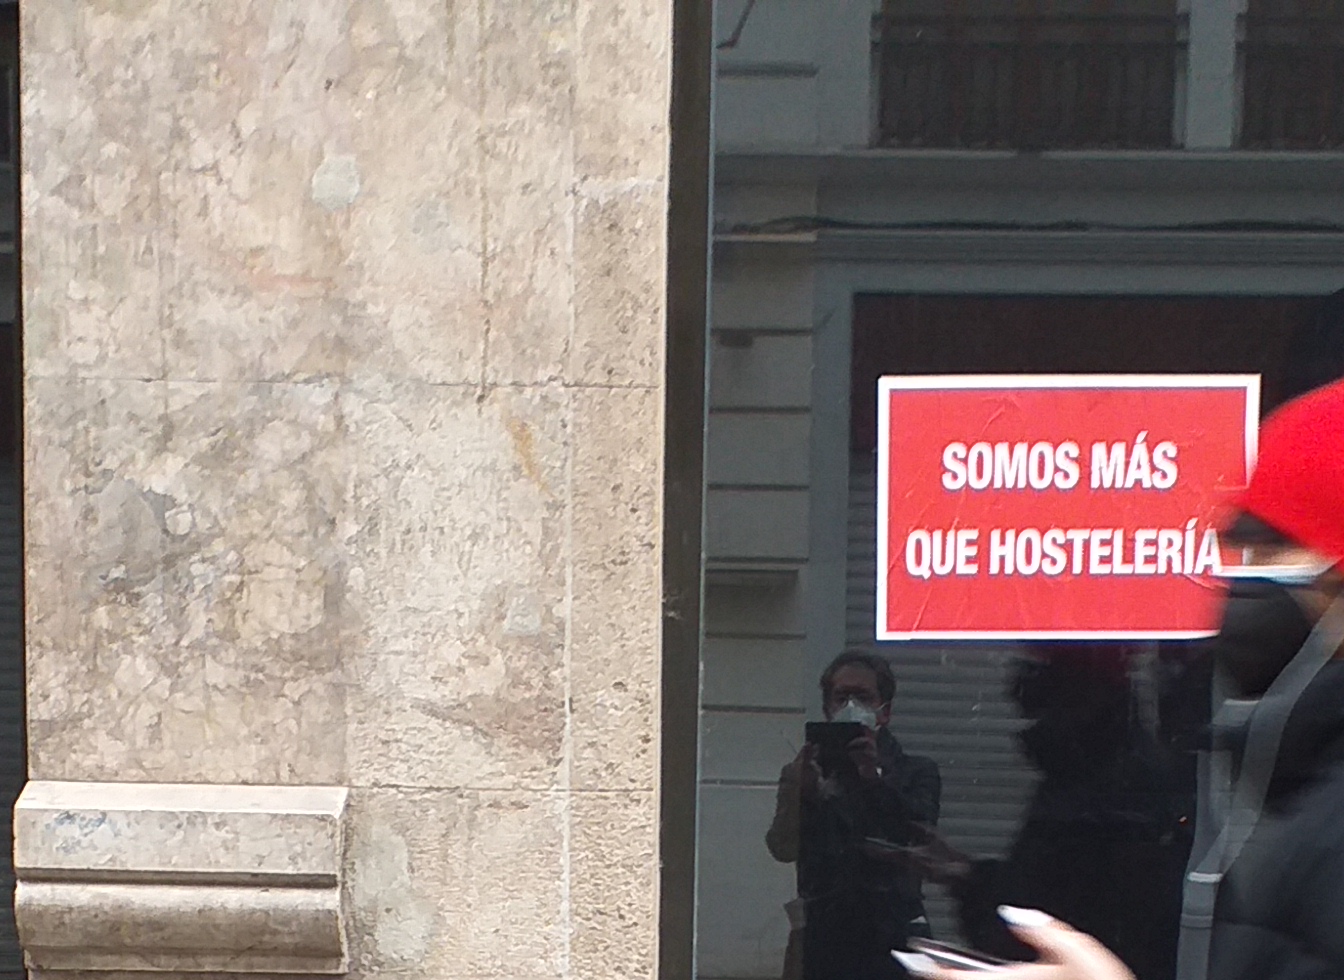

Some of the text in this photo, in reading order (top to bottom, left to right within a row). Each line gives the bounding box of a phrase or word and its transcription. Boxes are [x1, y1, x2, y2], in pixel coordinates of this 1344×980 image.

[941, 431, 1179, 490] SOMOS MÁS
[905, 518, 1223, 580] QUE HOSTELERÍA
